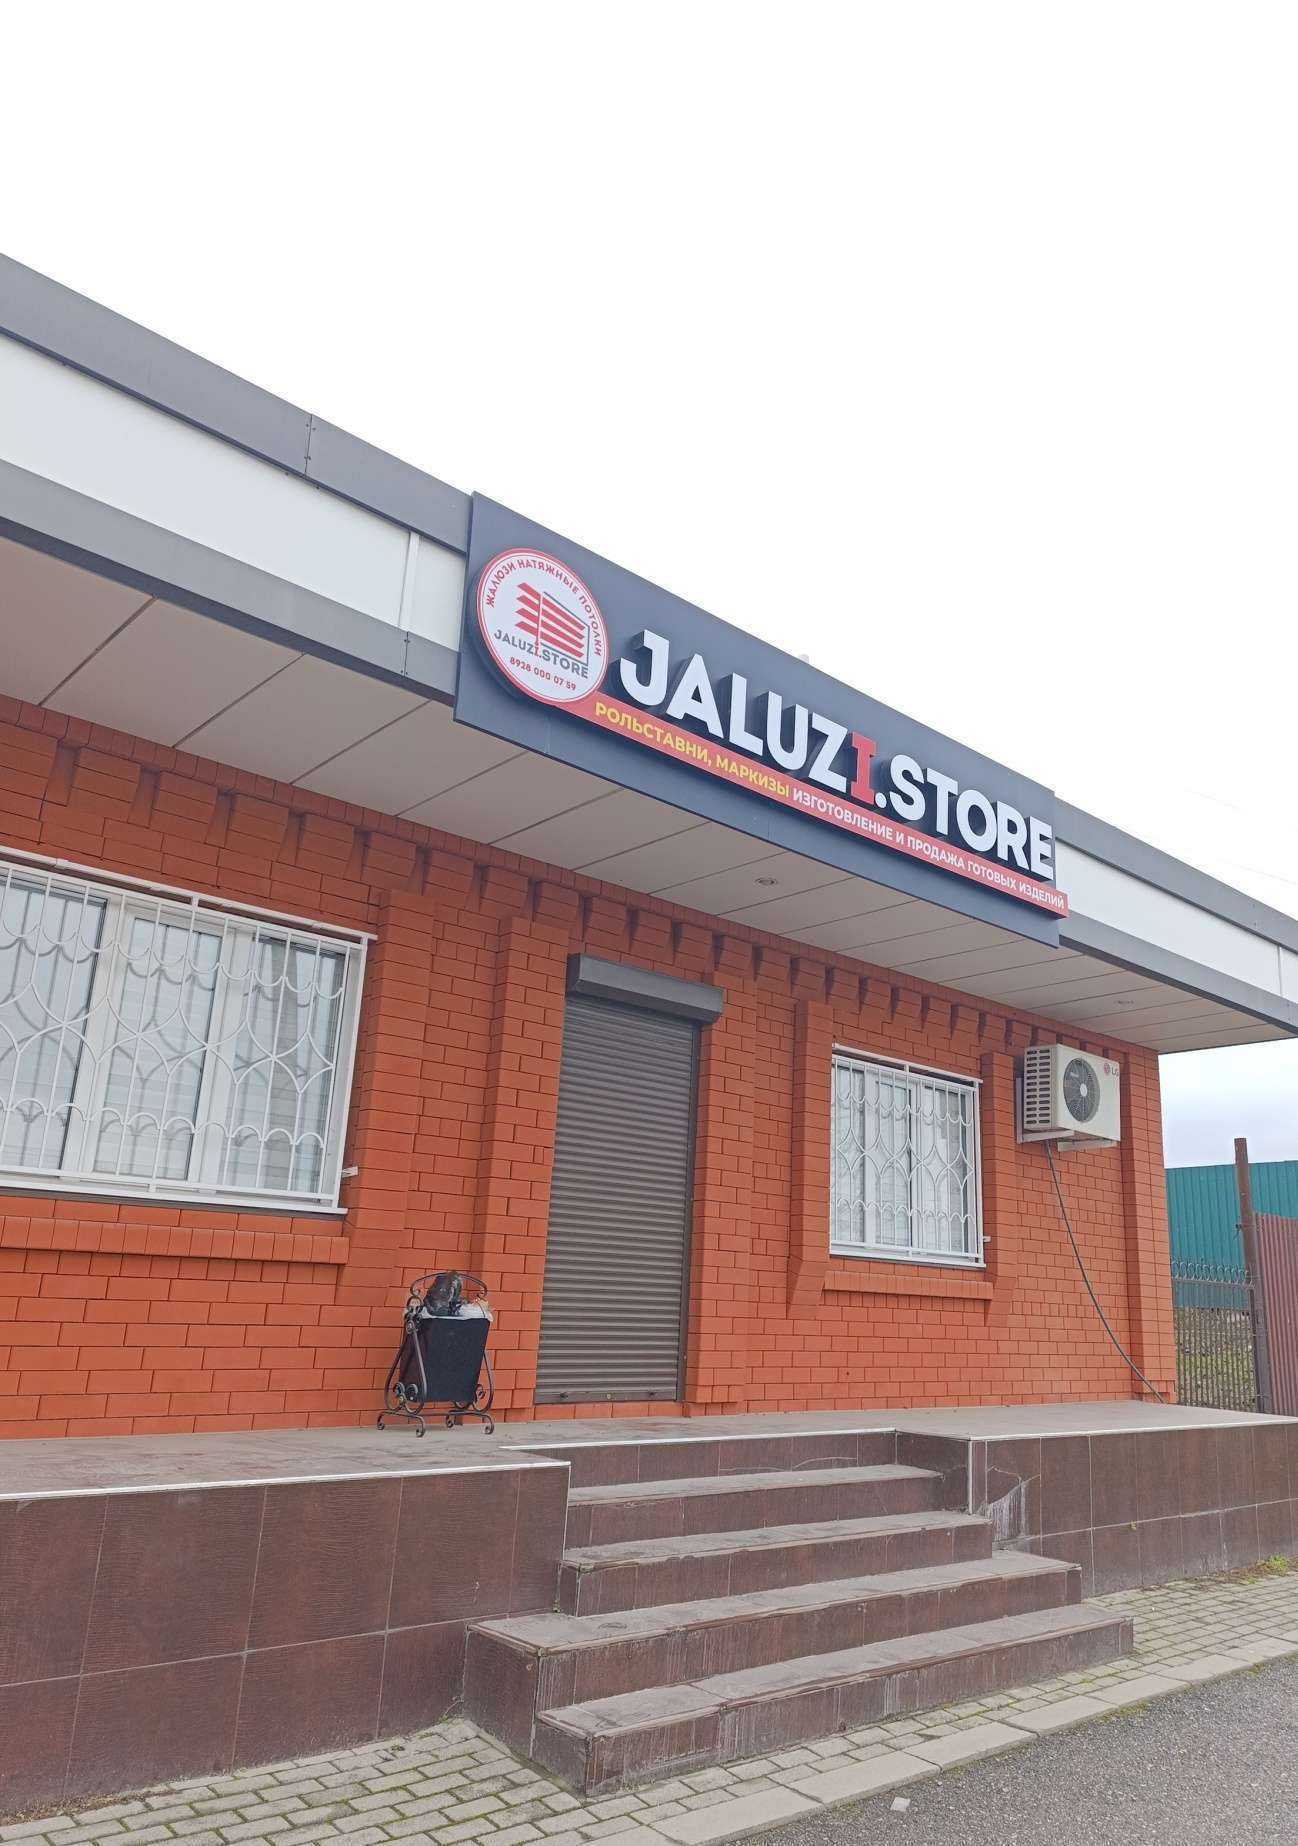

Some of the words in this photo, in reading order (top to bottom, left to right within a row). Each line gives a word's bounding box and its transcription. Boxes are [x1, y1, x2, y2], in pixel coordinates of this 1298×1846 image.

[486, 562, 517, 608] ЖАЛЮЗИ
[517, 559, 581, 594] НАТЯЖНЫЕ
[578, 595, 602, 657] ПОТОЛКИ
[509, 656, 531, 672] 8928
[533, 666, 551, 681] 000
[553, 675, 565, 686] 07
[565, 680, 577, 691] 59
[595, 701, 712, 766] РОЛЬСТАВНИ,
[716, 754, 790, 798] МАРКИЗЫ
[792, 787, 893, 841] ИЗГОТОВЛЕНИЕ
[895, 831, 905, 846] И
[907, 836, 965, 870] ПРОДАЖА
[967, 861, 1017, 891] ГОТОВЫХ
[1019, 881, 1065, 910] ИЗДЕЛИЙ
[619, 629, 1054, 881] JALUZI.STORE
